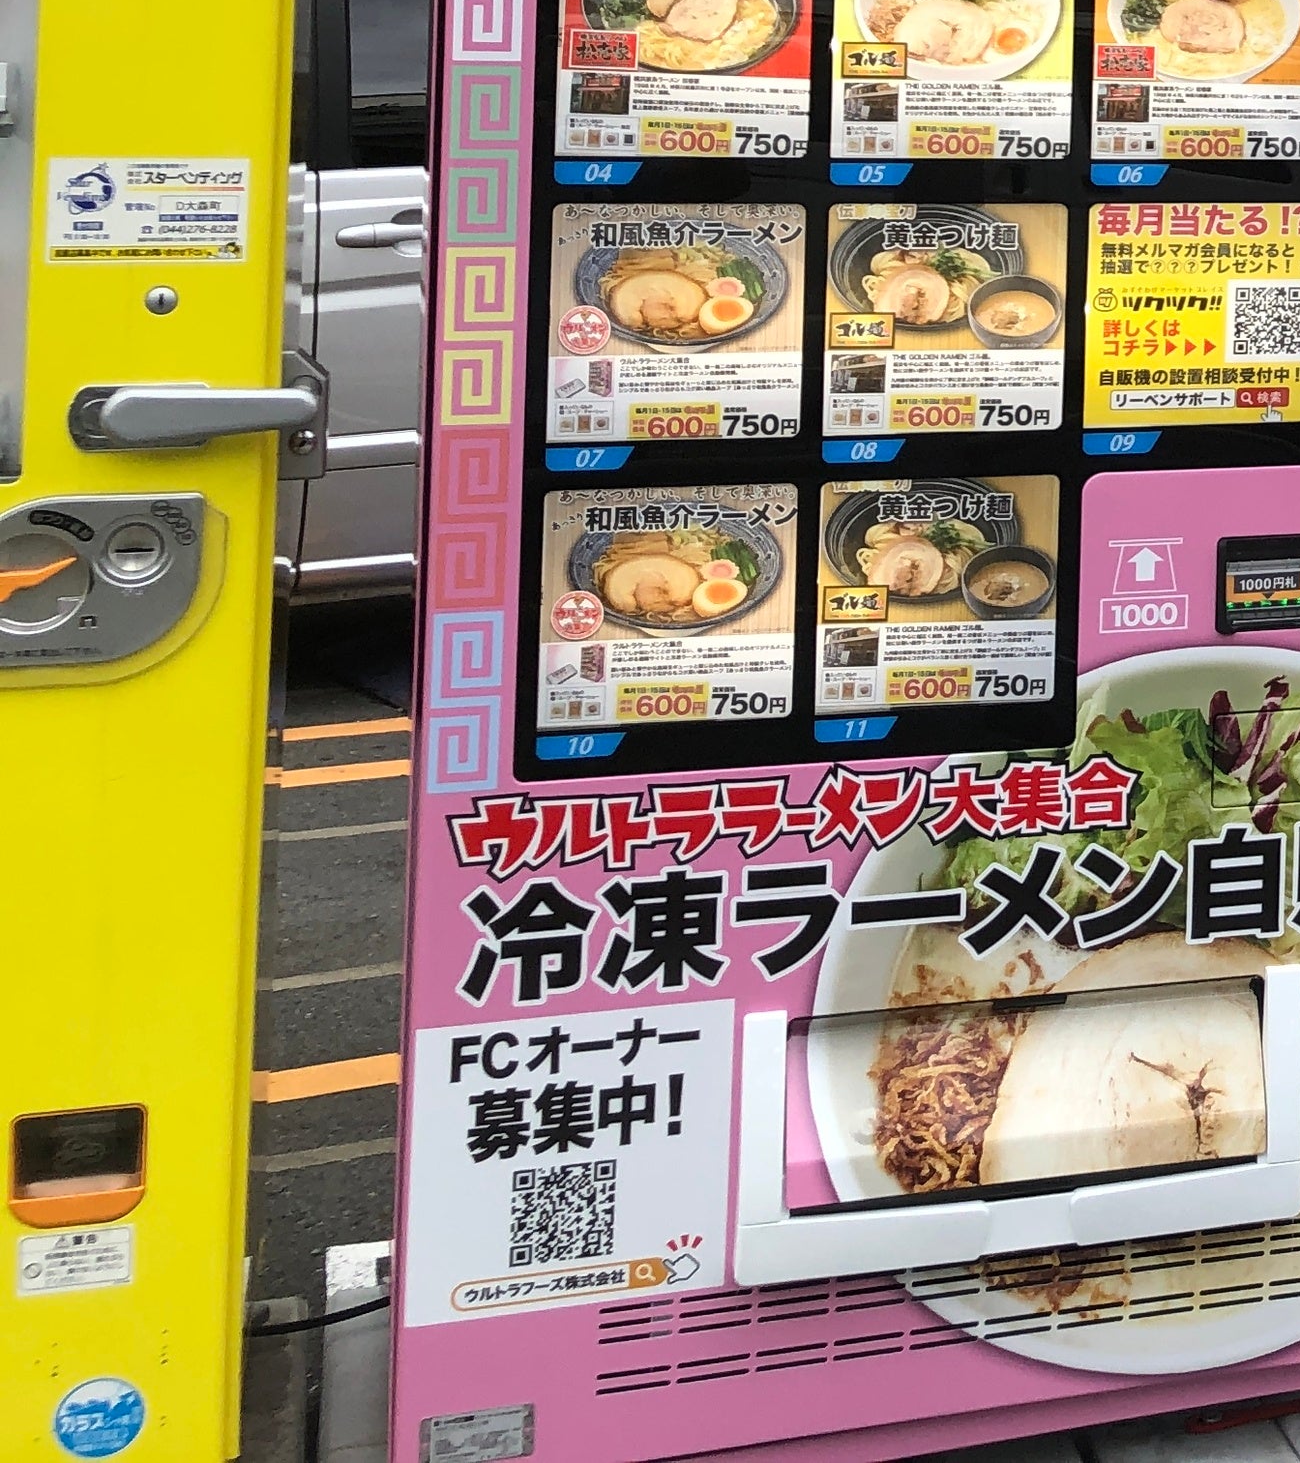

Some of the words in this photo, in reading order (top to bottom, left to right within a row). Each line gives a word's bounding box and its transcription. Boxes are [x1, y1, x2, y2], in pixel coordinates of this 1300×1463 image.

[660, 130, 730, 153] 600円
[735, 133, 808, 156] 750円
[927, 134, 994, 156] 600円
[999, 137, 1069, 158] 750円
[1181, 138, 1244, 158] 600円
[144, 171, 242, 185] スターベンディング
[585, 164, 612, 182] 04
[859, 165, 885, 183] 05
[1118, 167, 1143, 184] 06
[591, 220, 804, 248] 和風魚介ラーメン
[883, 223, 1019, 250] 黄金つけ麺
[1101, 243, 1295, 258] 無料メルマガ会員になると
[1104, 320, 1180, 338] 詳しくは
[1104, 339, 1160, 356] コチラ
[1116, 392, 1231, 407] リーベンサポート
[1257, 391, 1283, 404] 検索
[908, 406, 975, 426] 600円
[980, 405, 1050, 426] 750円
[647, 416, 718, 438] 600円
[723, 415, 798, 436] 750円
[851, 442, 877, 460] 08
[1110, 434, 1135, 452] 09
[576, 449, 605, 468] 07
[877, 494, 1013, 522] 黄金つけ麺
[585, 503, 798, 533] 和風魚介ラーメン
[1238, 576, 1297, 591] 1000円札
[1111, 602, 1178, 628] 1000
[904, 679, 971, 699] 600円
[975, 676, 1046, 698] 750円
[636, 695, 706, 716] 600円
[711, 692, 786, 715] 750円
[845, 720, 867, 738] 11
[567, 737, 594, 755] 10
[449, 760, 1143, 875] ウルトララーメン大集合
[464, 1268, 626, 1304] ウルトラフーズ株式会社
